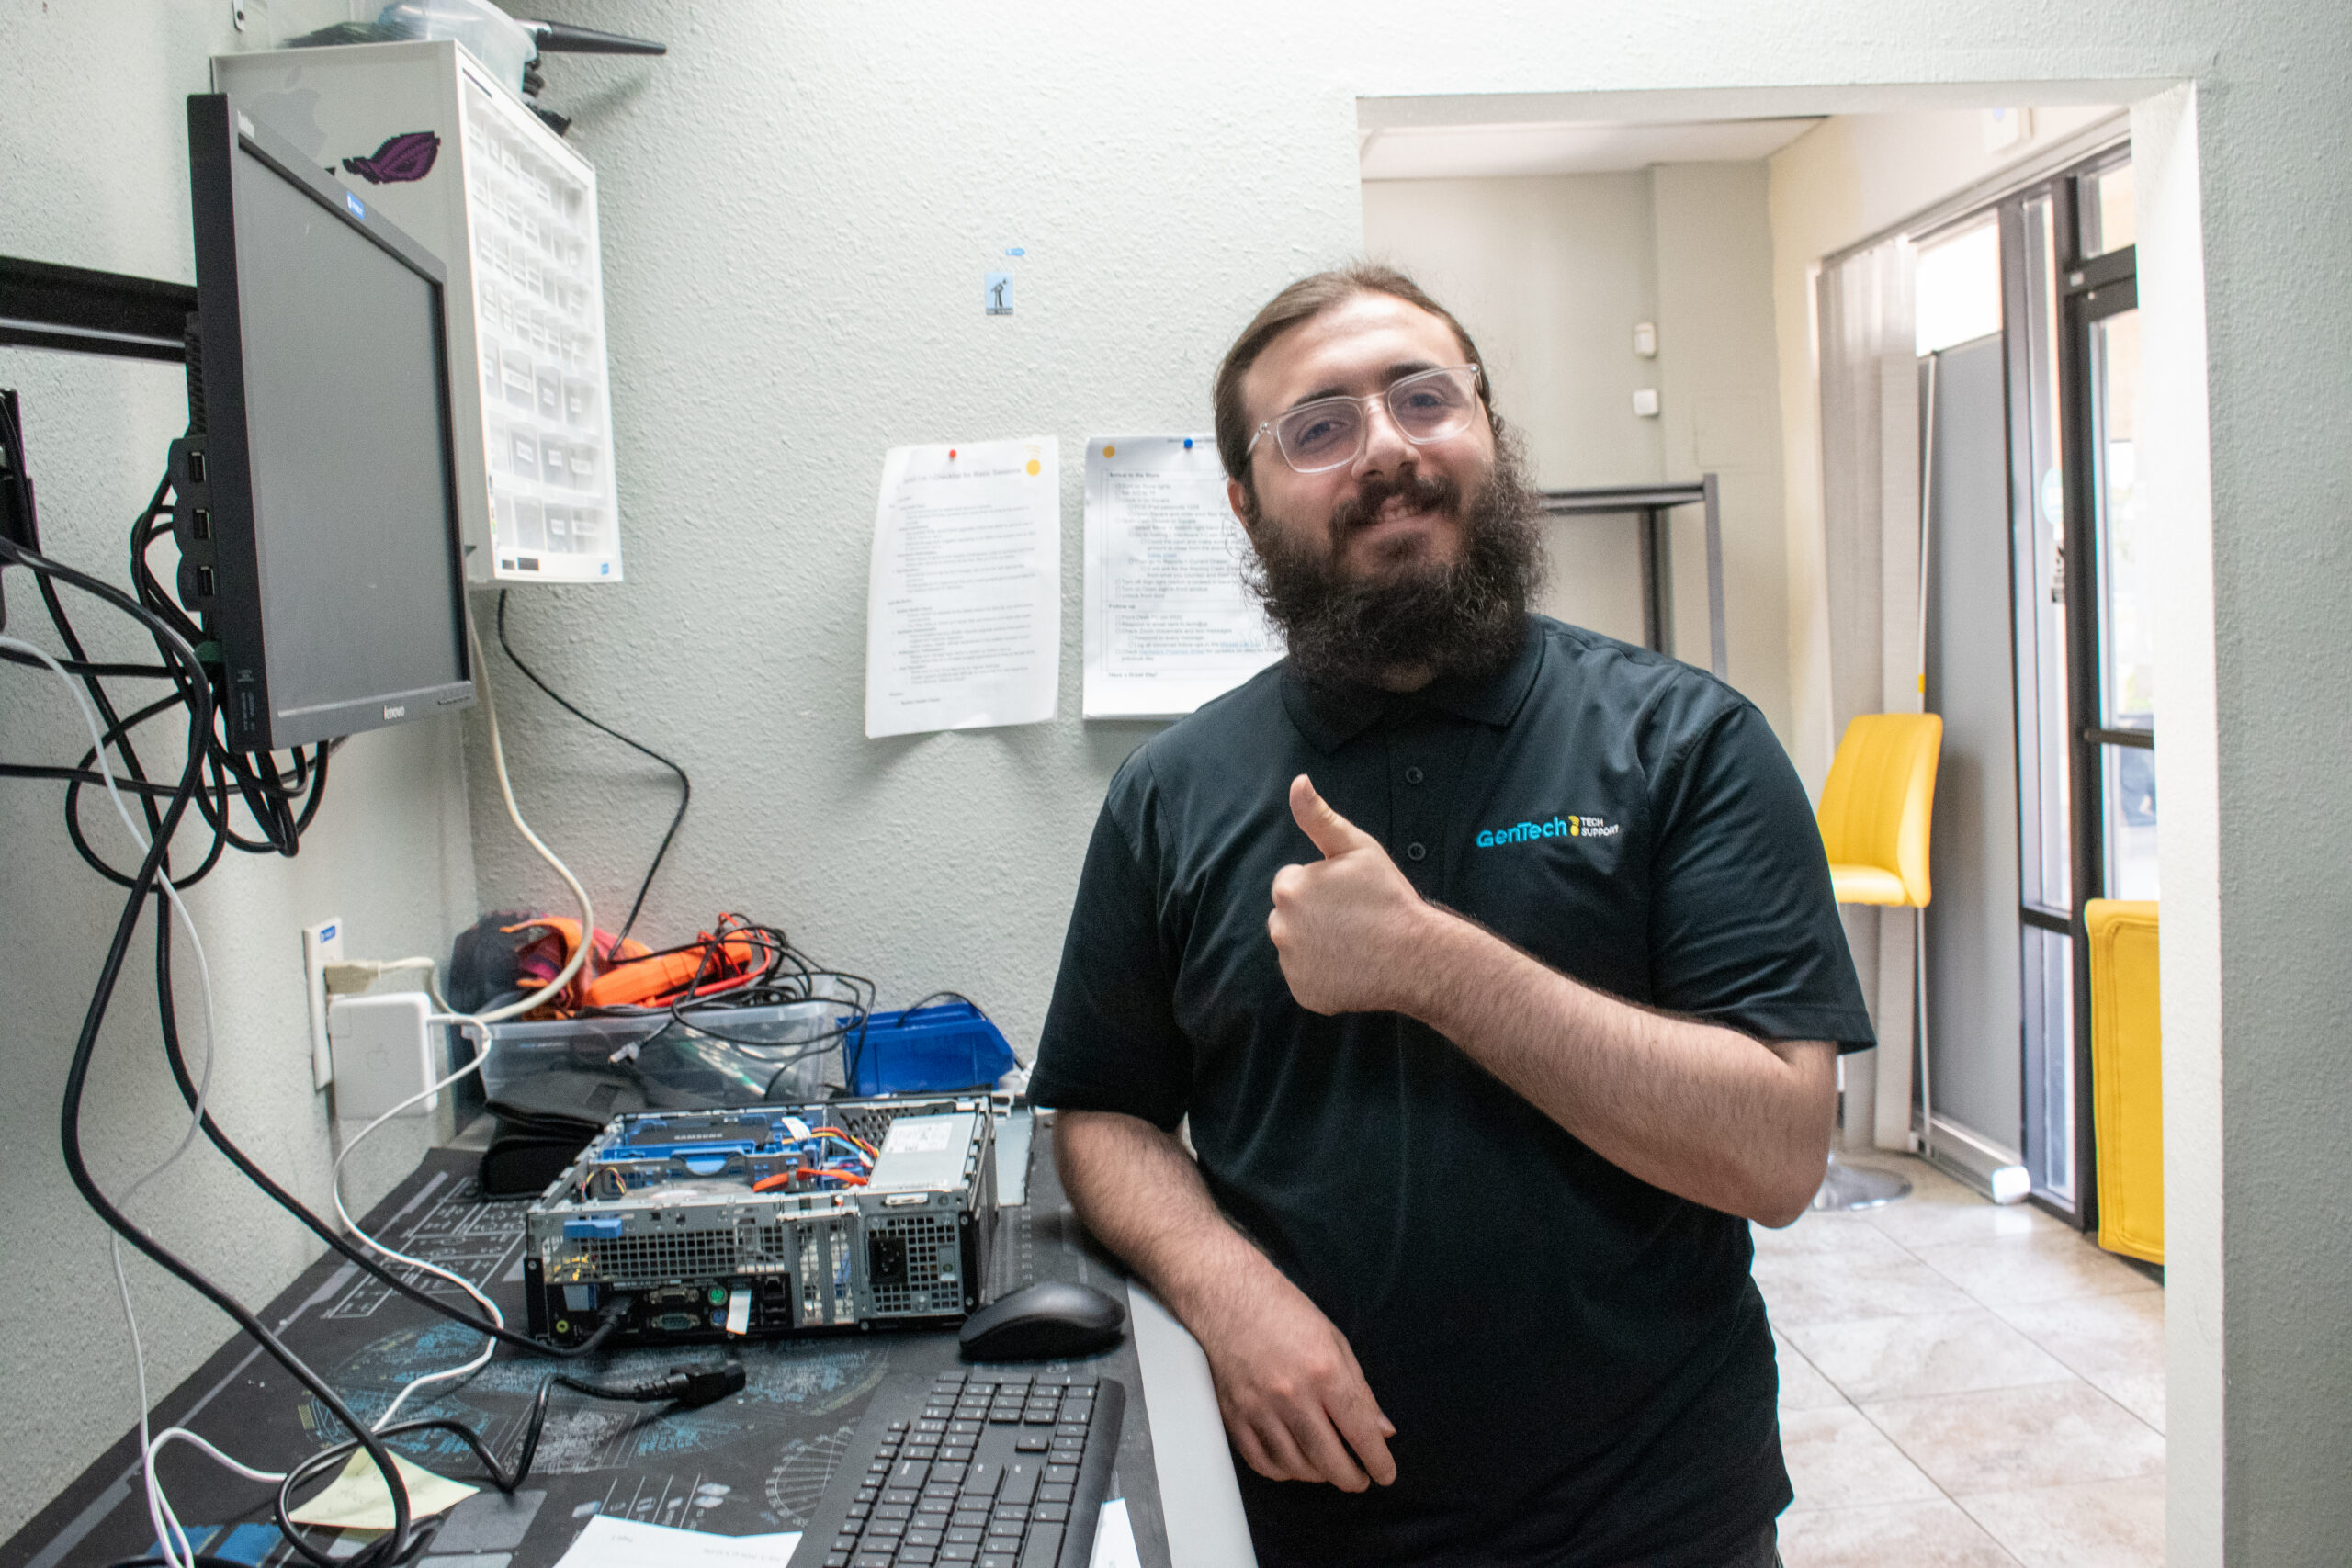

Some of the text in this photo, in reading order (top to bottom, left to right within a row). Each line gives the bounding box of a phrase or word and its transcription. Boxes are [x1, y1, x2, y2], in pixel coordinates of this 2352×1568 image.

[1580, 816, 1603, 827] TECH
[1476, 815, 1567, 848] GenTech
[1581, 824, 1619, 837] SUPPORT
